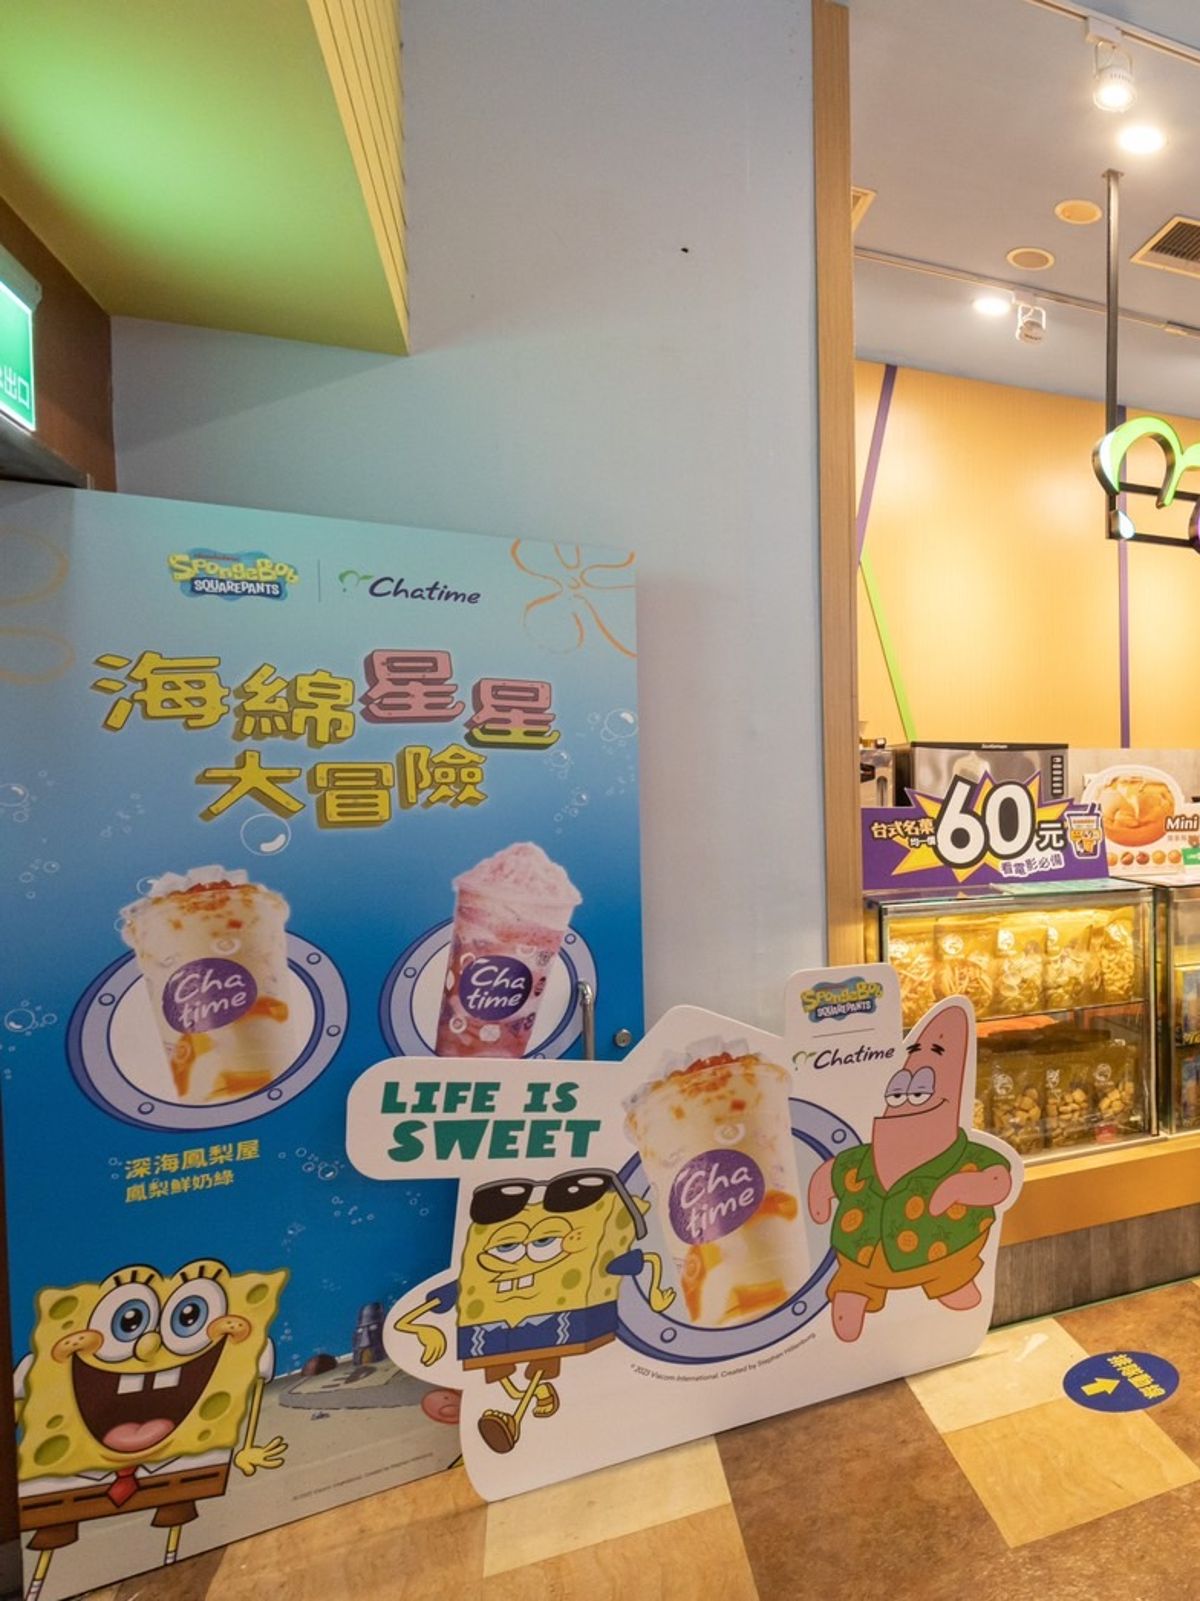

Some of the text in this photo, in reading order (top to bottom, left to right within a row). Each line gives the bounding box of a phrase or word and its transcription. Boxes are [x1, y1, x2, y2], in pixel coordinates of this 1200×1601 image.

[0, 366, 29, 409] 出口
[193, 579, 280, 596] SQUAREPANTS
[368, 576, 481, 604] Chatime
[92, 649, 562, 750] 海綿星星
[196, 743, 489, 830] 大冒險
[1166, 815, 1199, 831] Mini
[174, 967, 247, 1003] Cha
[470, 957, 529, 990] Cha
[179, 989, 248, 1029] time
[467, 987, 522, 1010] time
[813, 1045, 895, 1070] Chatime
[381, 1081, 580, 1114] LIFE IS
[387, 1119, 602, 1163] SWEET
[124, 1139, 261, 1180] 深海鳳梨屋
[125, 1169, 235, 1203] 鳳梨鮮奶綠
[681, 1163, 753, 1209] Cha
[686, 1188, 754, 1238] time
